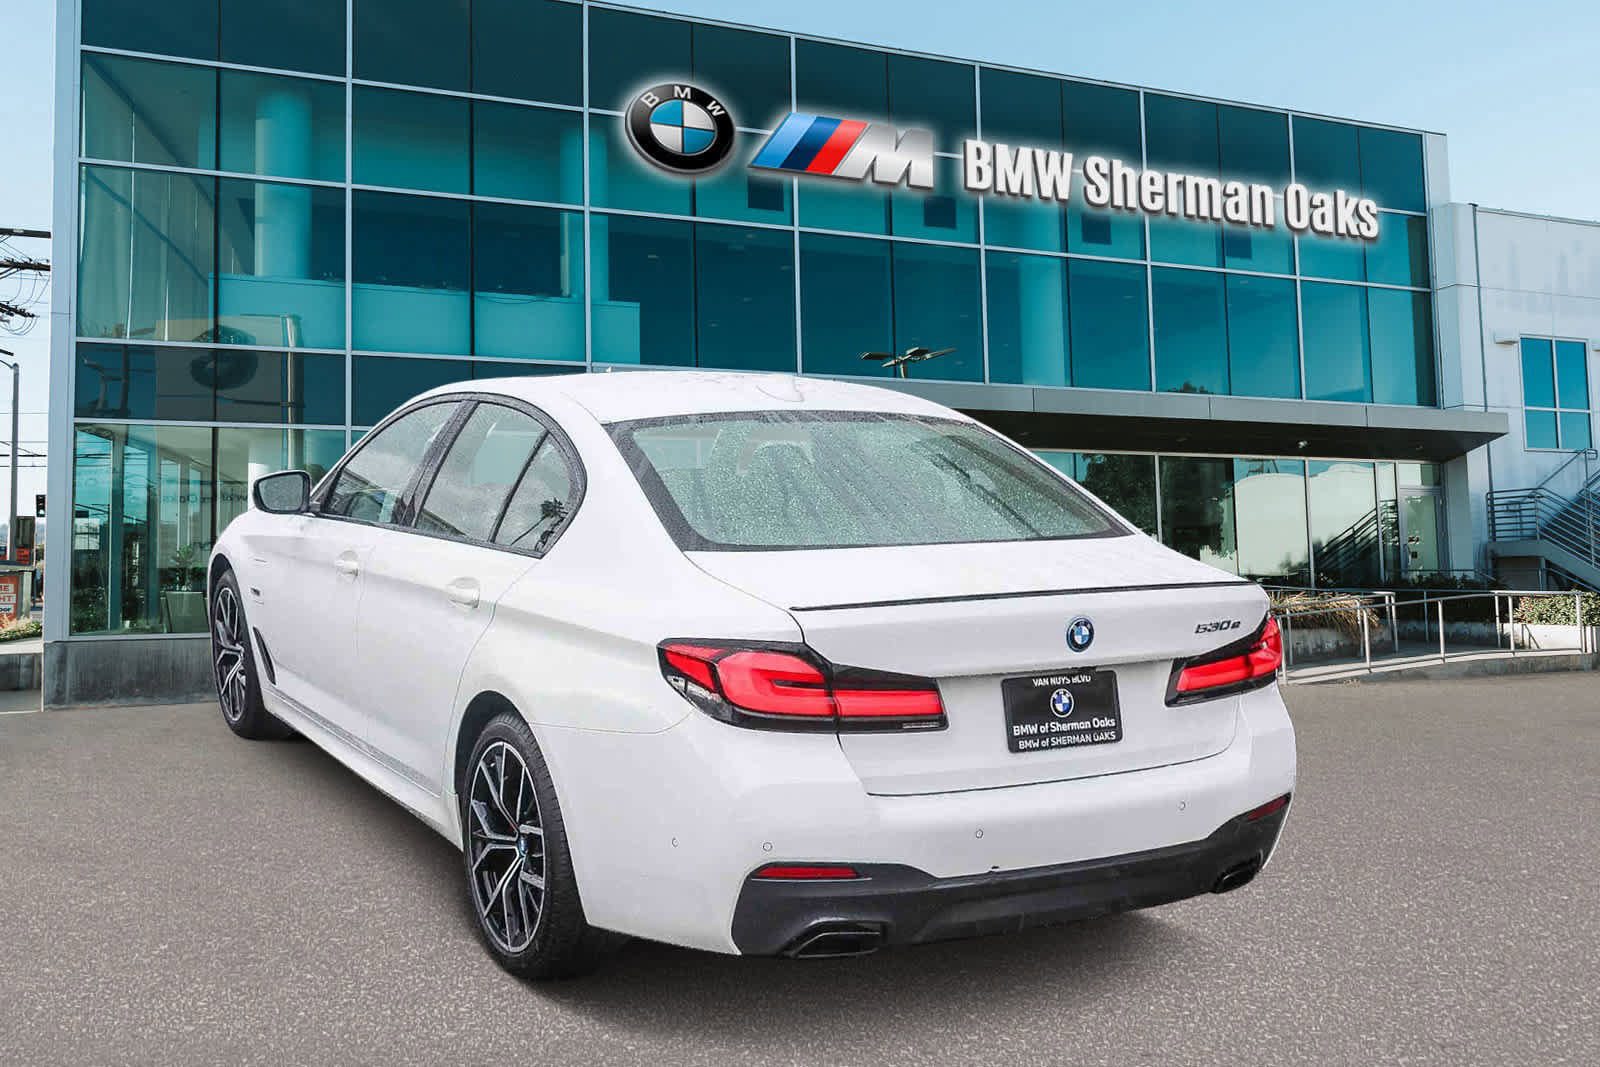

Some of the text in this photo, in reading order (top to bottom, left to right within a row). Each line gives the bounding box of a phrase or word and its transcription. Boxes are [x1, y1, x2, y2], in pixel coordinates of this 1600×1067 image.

[641, 85, 725, 117] BMW
[964, 138, 1379, 240] BMW Sherman Oaks
[1032, 677, 1049, 687] VAN
[1050, 676, 1071, 685] NUYS
[1013, 717, 1116, 736] BMW of Sherman Oaks
[1018, 731, 1116, 750] BMW of SHERMAN OAKS
